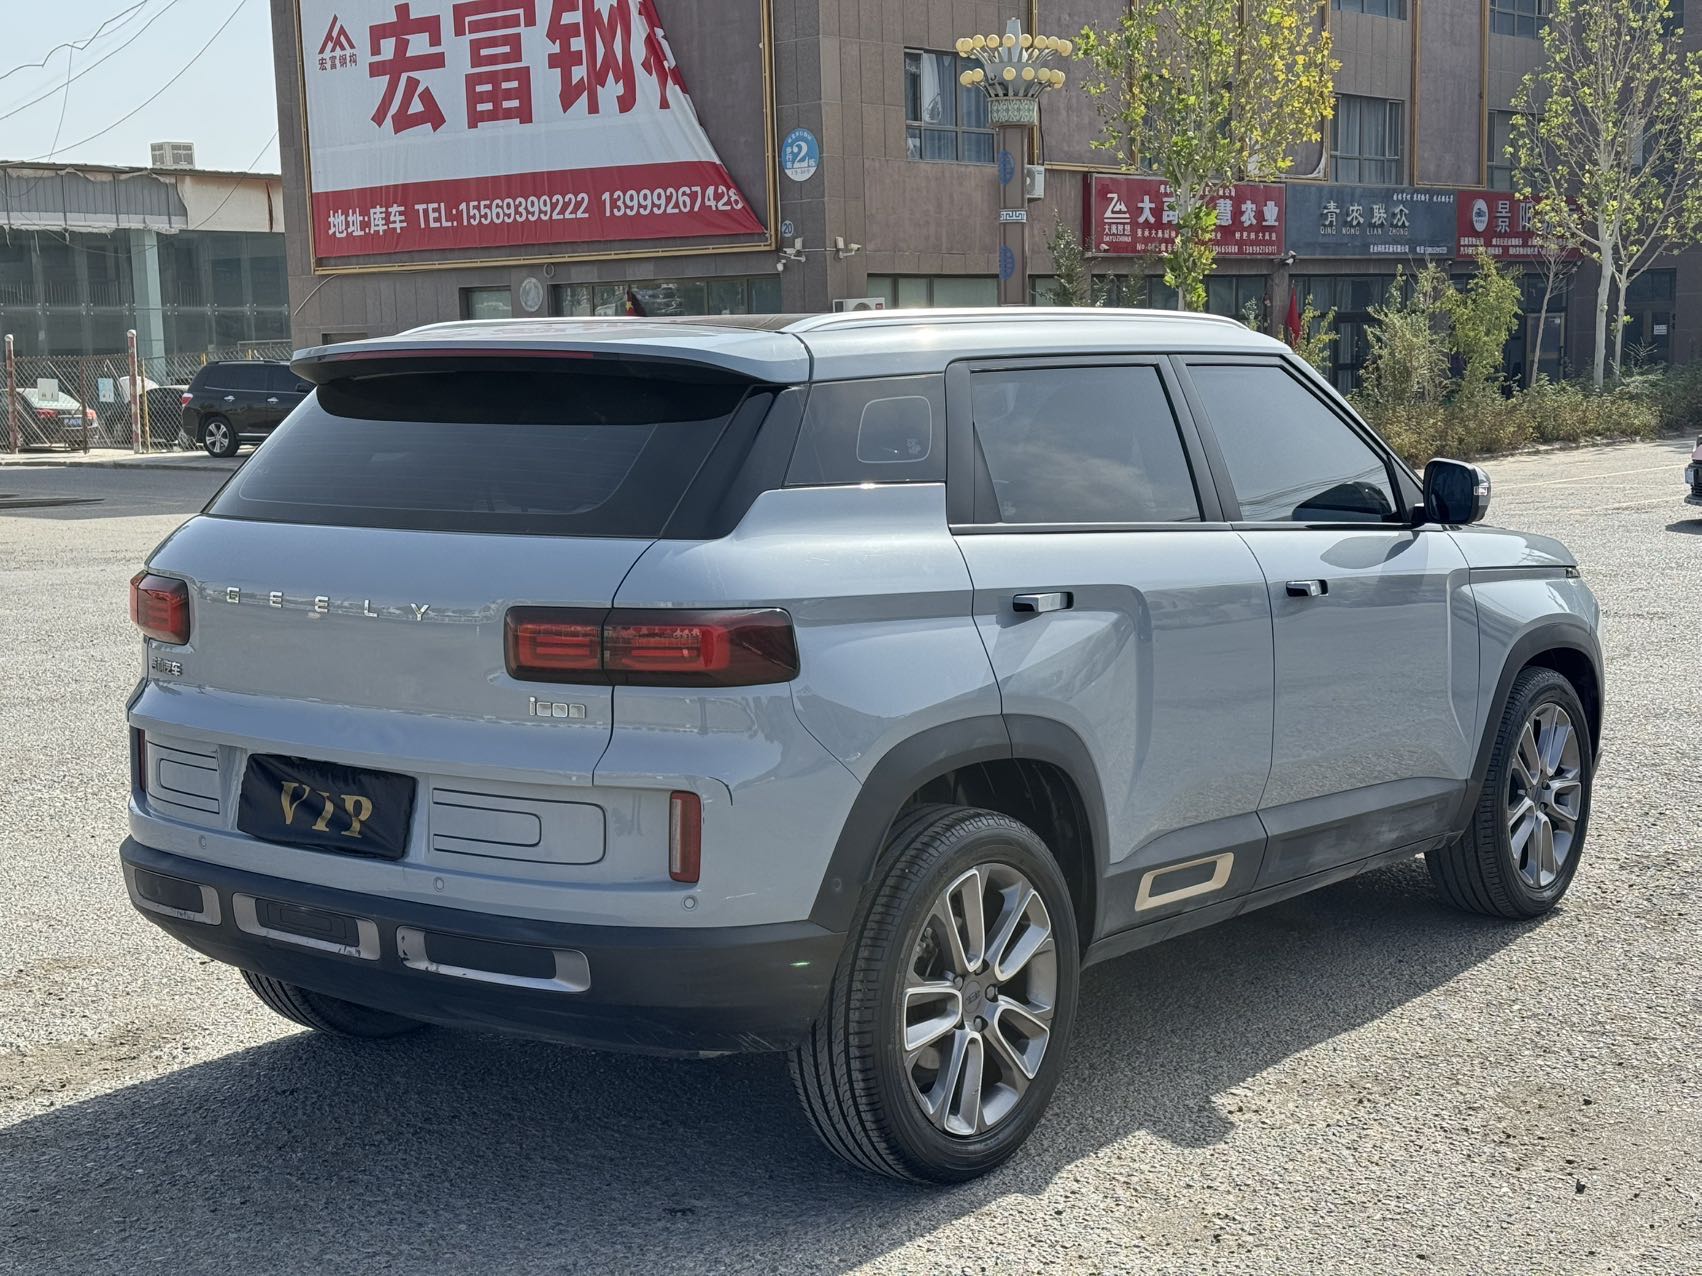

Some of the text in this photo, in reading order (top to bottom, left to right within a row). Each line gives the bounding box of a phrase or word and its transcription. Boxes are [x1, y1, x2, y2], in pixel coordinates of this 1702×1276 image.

[318, 52, 358, 71] 宏富钢构
[793, 141, 809, 168] 2
[328, 204, 408, 238] 地址:库车
[414, 193, 590, 229] TEL:15569399222
[1137, 195, 1279, 227] 大禹慧农业
[1323, 200, 1410, 226] 青农联众
[783, 223, 793, 235] 20
[1320, 226, 1408, 235] QING NONG LIAN ZHONG
[226, 587, 430, 621] GEELY
[529, 696, 587, 719] icon
[280, 781, 373, 839] VIP
